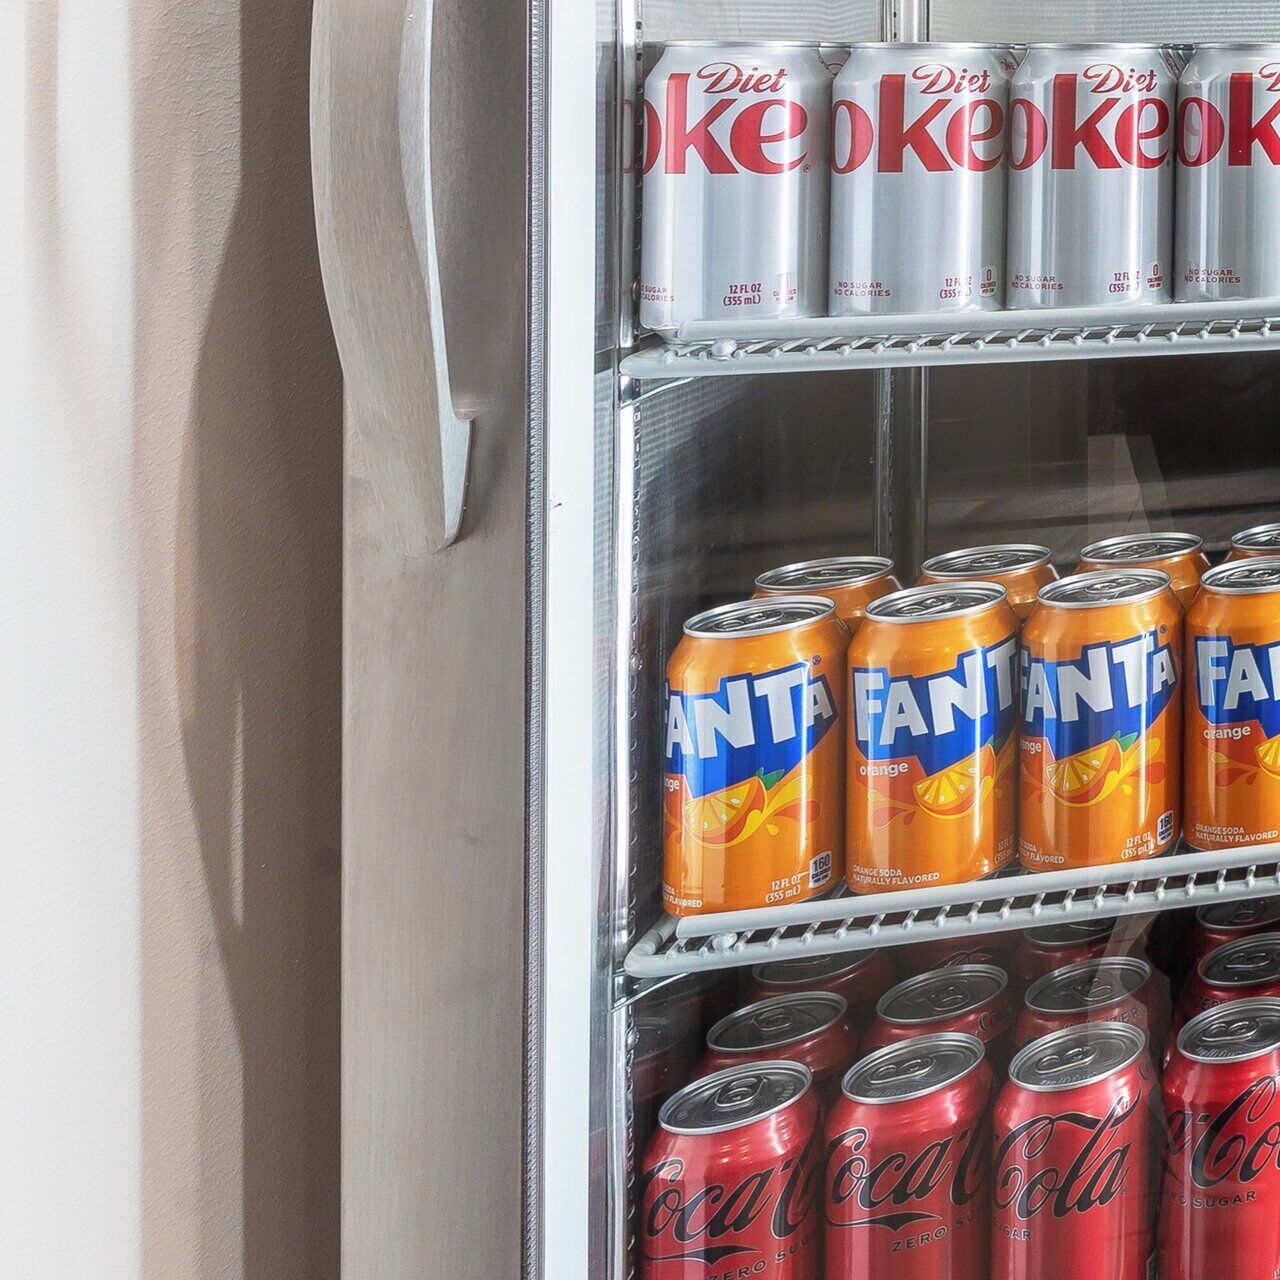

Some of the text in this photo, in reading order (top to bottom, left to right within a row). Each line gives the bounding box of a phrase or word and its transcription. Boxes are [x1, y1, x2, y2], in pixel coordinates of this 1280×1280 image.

[696, 62, 788, 94] Diet
[912, 63, 991, 94] Diet
[1083, 63, 1157, 93] Diet
[643, 73, 808, 175] oke
[832, 73, 1005, 175] oke
[1009, 73, 1170, 170] oke
[723, 295, 761, 306] (355 mL)
[852, 637, 1020, 746] FANT
[1019, 634, 1176, 723] FANTA
[665, 662, 833, 759] ANTA
[1203, 725, 1251, 740] orange
[859, 762, 909, 778] orange
[812, 854, 831, 872] 160
[892, 872, 940, 885] FLAVORED
[1192, 1191, 1257, 1209] SUGAR
[891, 1226, 947, 1254] ZERO
